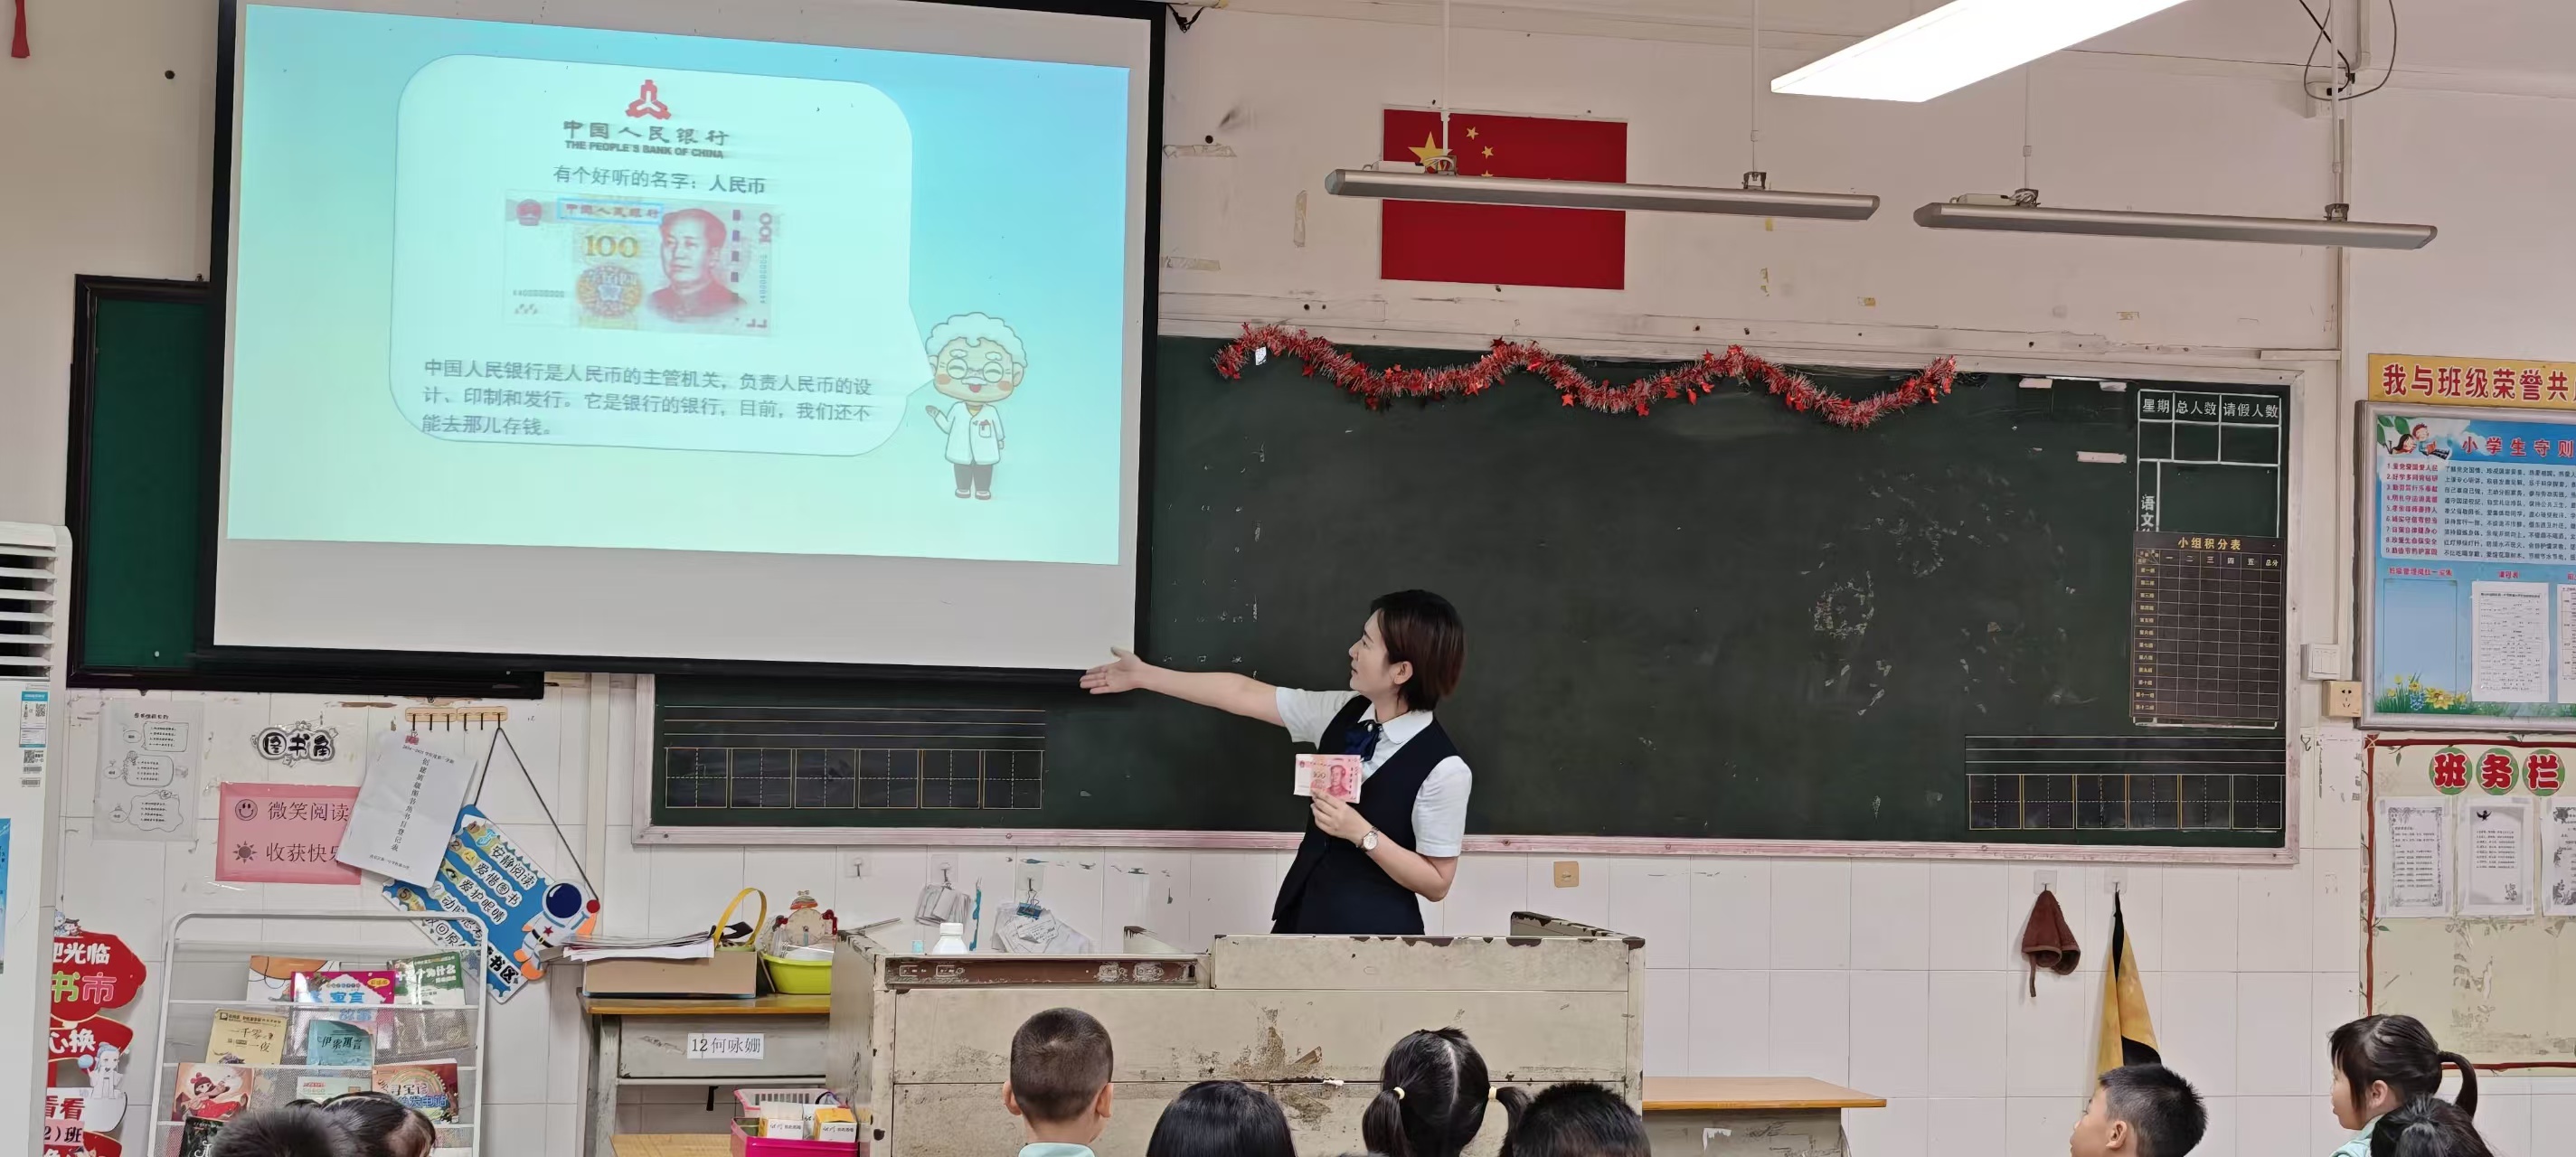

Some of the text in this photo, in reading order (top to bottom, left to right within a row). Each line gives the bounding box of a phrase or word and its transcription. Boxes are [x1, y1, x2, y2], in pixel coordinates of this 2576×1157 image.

[563, 119, 730, 146] 中国人民银行
[565, 140, 588, 149] THE
[643, 145, 673, 155] BANK
[675, 147, 688, 155] OF
[691, 148, 723, 158] CHINA
[759, 212, 773, 243] 100
[583, 235, 638, 259] 100
[424, 359, 872, 396] 中国人民银行是人民币的主管机关，负责人民币的设
[2383, 363, 2576, 401] 我与班级荣誉共
[422, 386, 872, 422] 计、印制和发行。它是银行的银行，目前，我们还不
[2142, 399, 2170, 413] 星期
[2175, 400, 2217, 416] 总人数
[2222, 402, 2279, 419] 请假人数
[421, 414, 552, 437] 能去那儿存钱。
[2462, 436, 2574, 458] 小学生守则
[2140, 494, 2155, 531] 语文
[2178, 537, 2241, 550] 小组积分表
[2206, 556, 2214, 564] 三
[2227, 557, 2235, 565] 四
[262, 731, 331, 757] 图书角
[2433, 753, 2560, 791] 班务栏
[268, 801, 350, 822] 微笑阅读
[490, 844, 536, 890] 安静阅读
[474, 862, 520, 908] 爱惜图书
[458, 879, 507, 924] 爱护眼睛
[52, 970, 118, 1004] 书市
[321, 1036, 363, 1051] 伊索寓言
